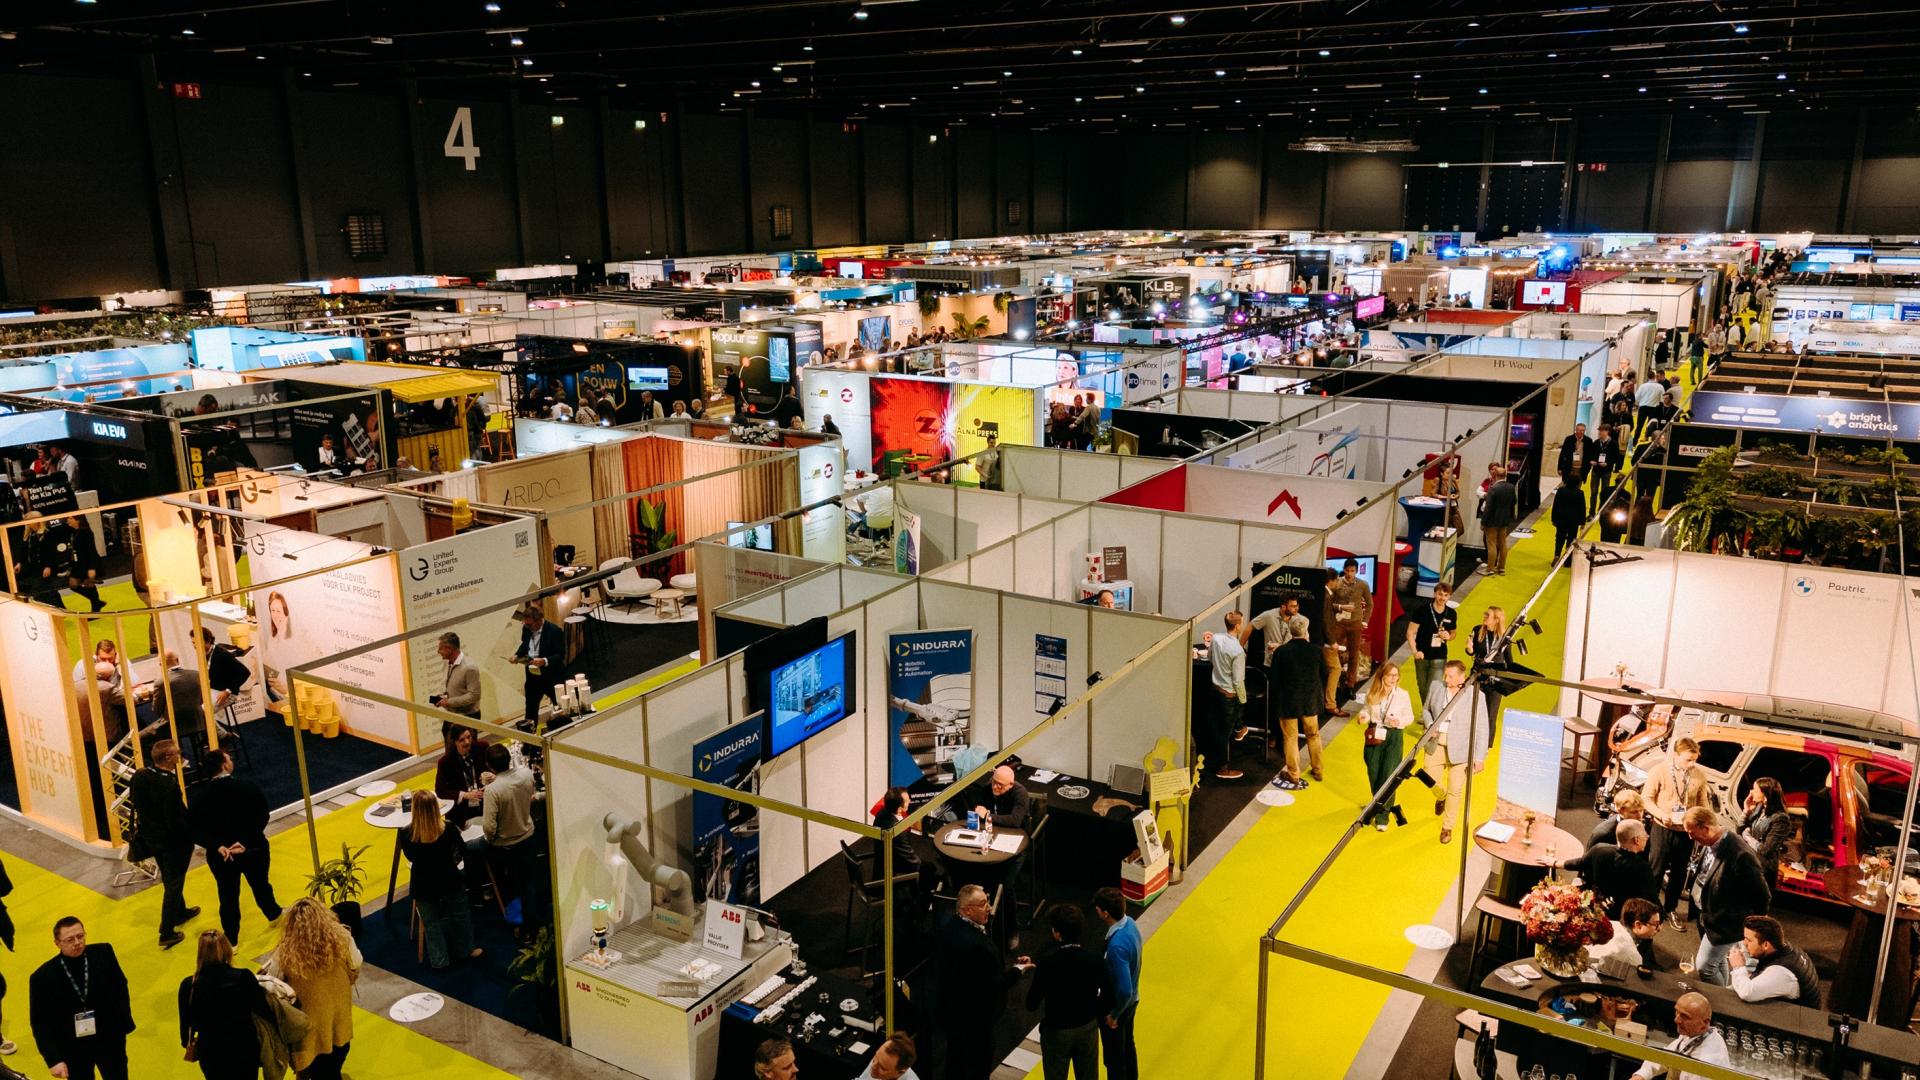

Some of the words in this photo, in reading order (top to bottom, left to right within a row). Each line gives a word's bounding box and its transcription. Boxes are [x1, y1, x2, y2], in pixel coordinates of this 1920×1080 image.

[444, 107, 480, 170] 4
[1144, 281, 1174, 291] KLB
[1849, 412, 1882, 422] bright
[93, 422, 109, 436] KIA
[110, 424, 126, 439] EV4
[1848, 421, 1898, 431] analytics
[28, 486, 42, 494] Test
[504, 478, 560, 505] ARIDO
[433, 550, 454, 561] United
[433, 557, 458, 568] Experts
[434, 566, 454, 576] Group
[1276, 573, 1301, 586] ella
[322, 577, 339, 590] VOOR
[353, 585, 381, 600] PROJECT
[412, 592, 434, 602] Studie-
[442, 578, 484, 594] adviesbureaus
[912, 641, 966, 651] INDURRA
[233, 701, 256, 710] Experts
[235, 708, 252, 716] Group
[19, 712, 45, 741] THE
[713, 732, 759, 761] INDURRA
[24, 740, 73, 778] EXPERT
[29, 767, 56, 797] HUB
[721, 909, 741, 923] ABB
[708, 932, 722, 940] VALUE
[708, 939, 729, 951] PROVIDER
[576, 981, 591, 993] ABB
[595, 986, 631, 1004] ENGINEERED
[694, 1003, 714, 1026] ABB
